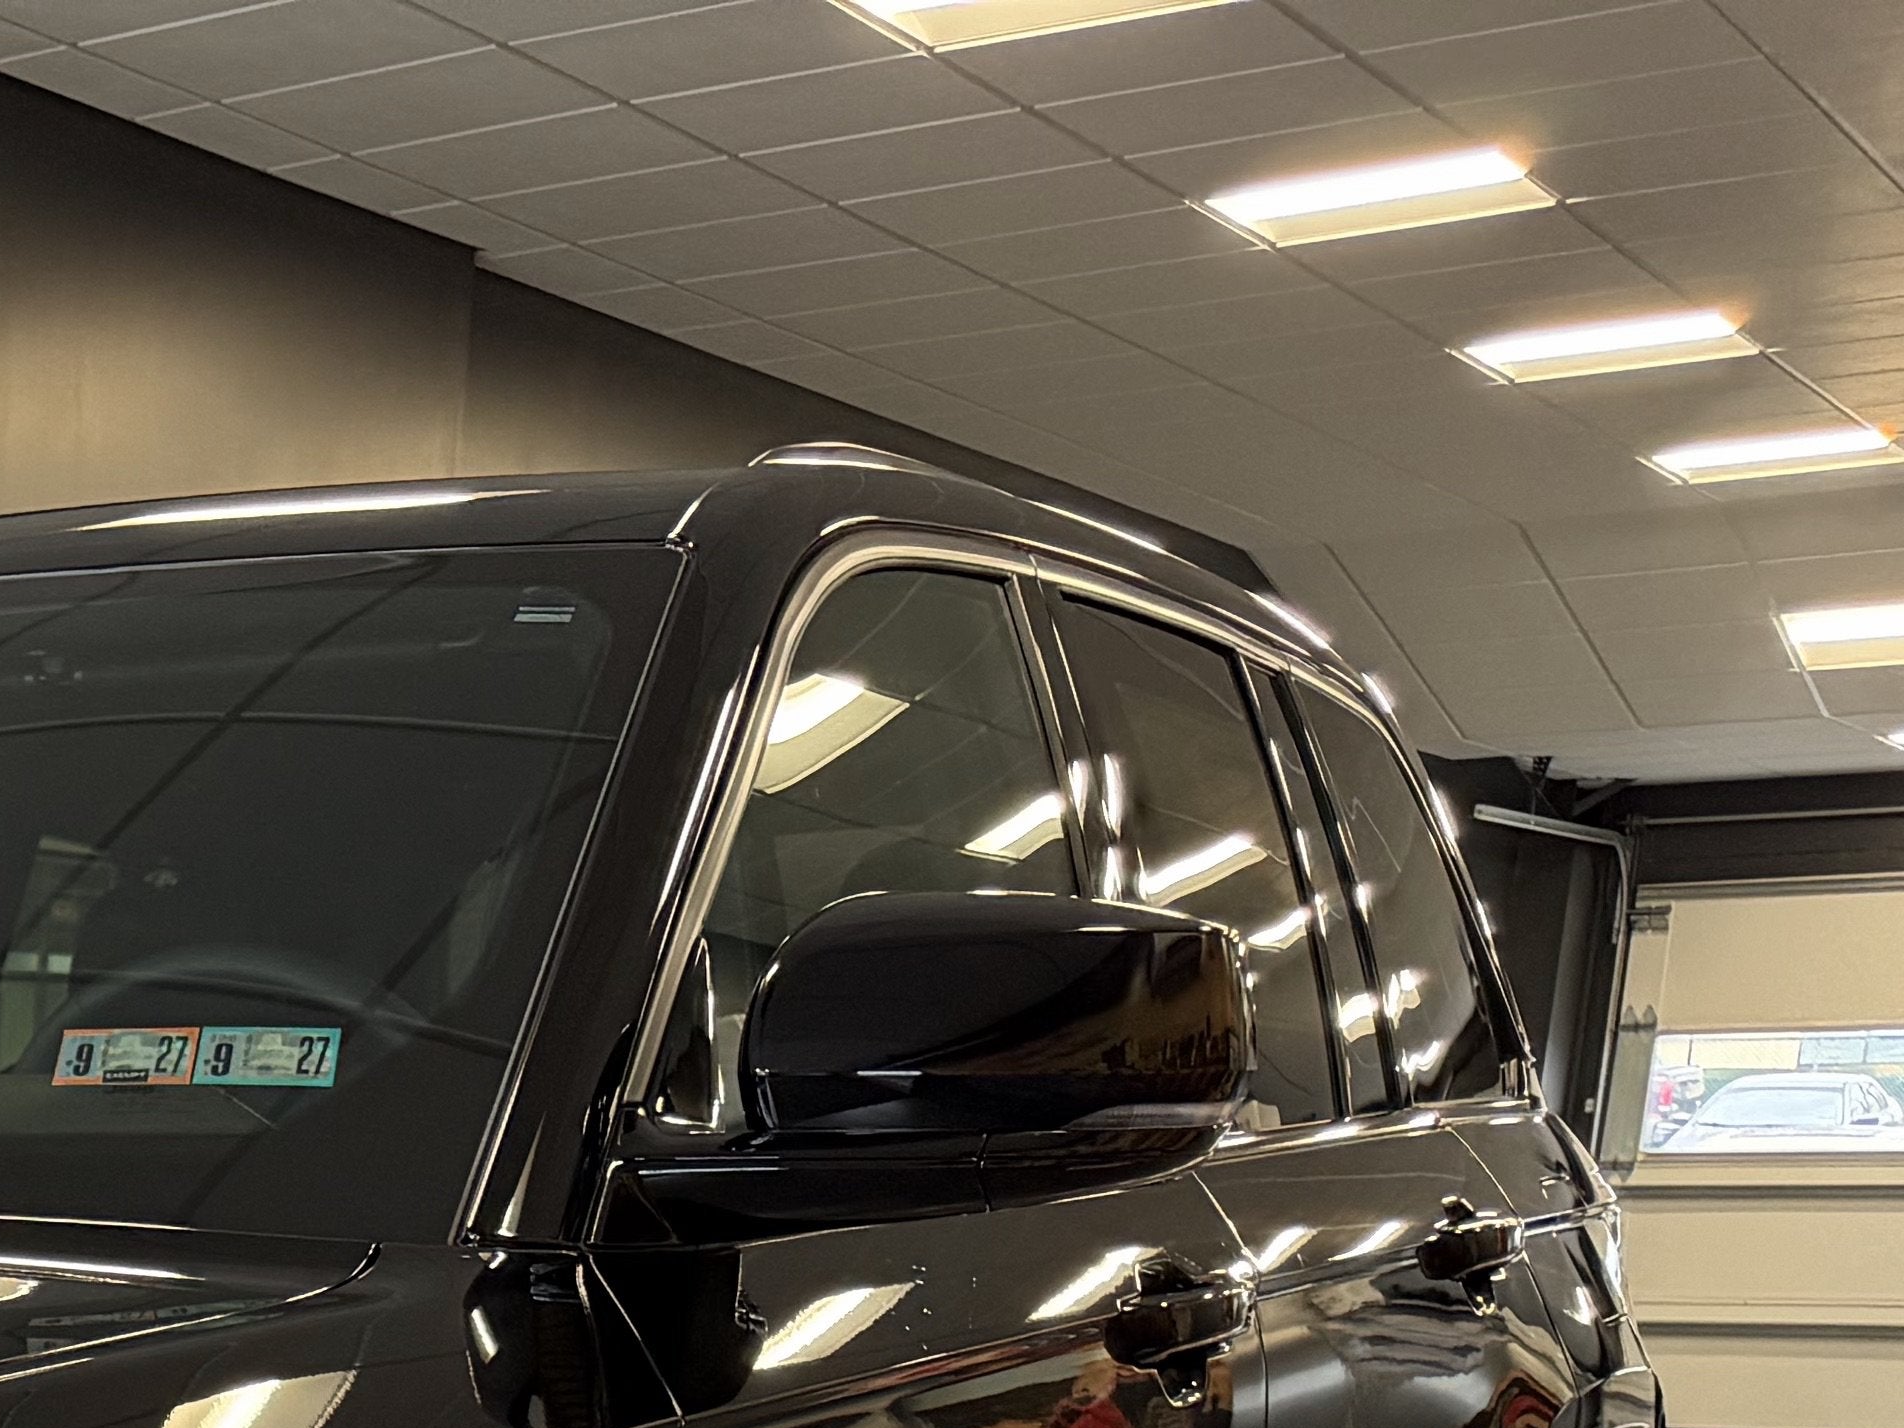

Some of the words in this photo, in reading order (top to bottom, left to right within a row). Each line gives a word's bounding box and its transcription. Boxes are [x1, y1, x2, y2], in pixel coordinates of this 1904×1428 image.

[72, 1043, 95, 1077] 9
[153, 1035, 190, 1077] 27
[210, 1042, 234, 1077] 9
[295, 1036, 331, 1077] 27
